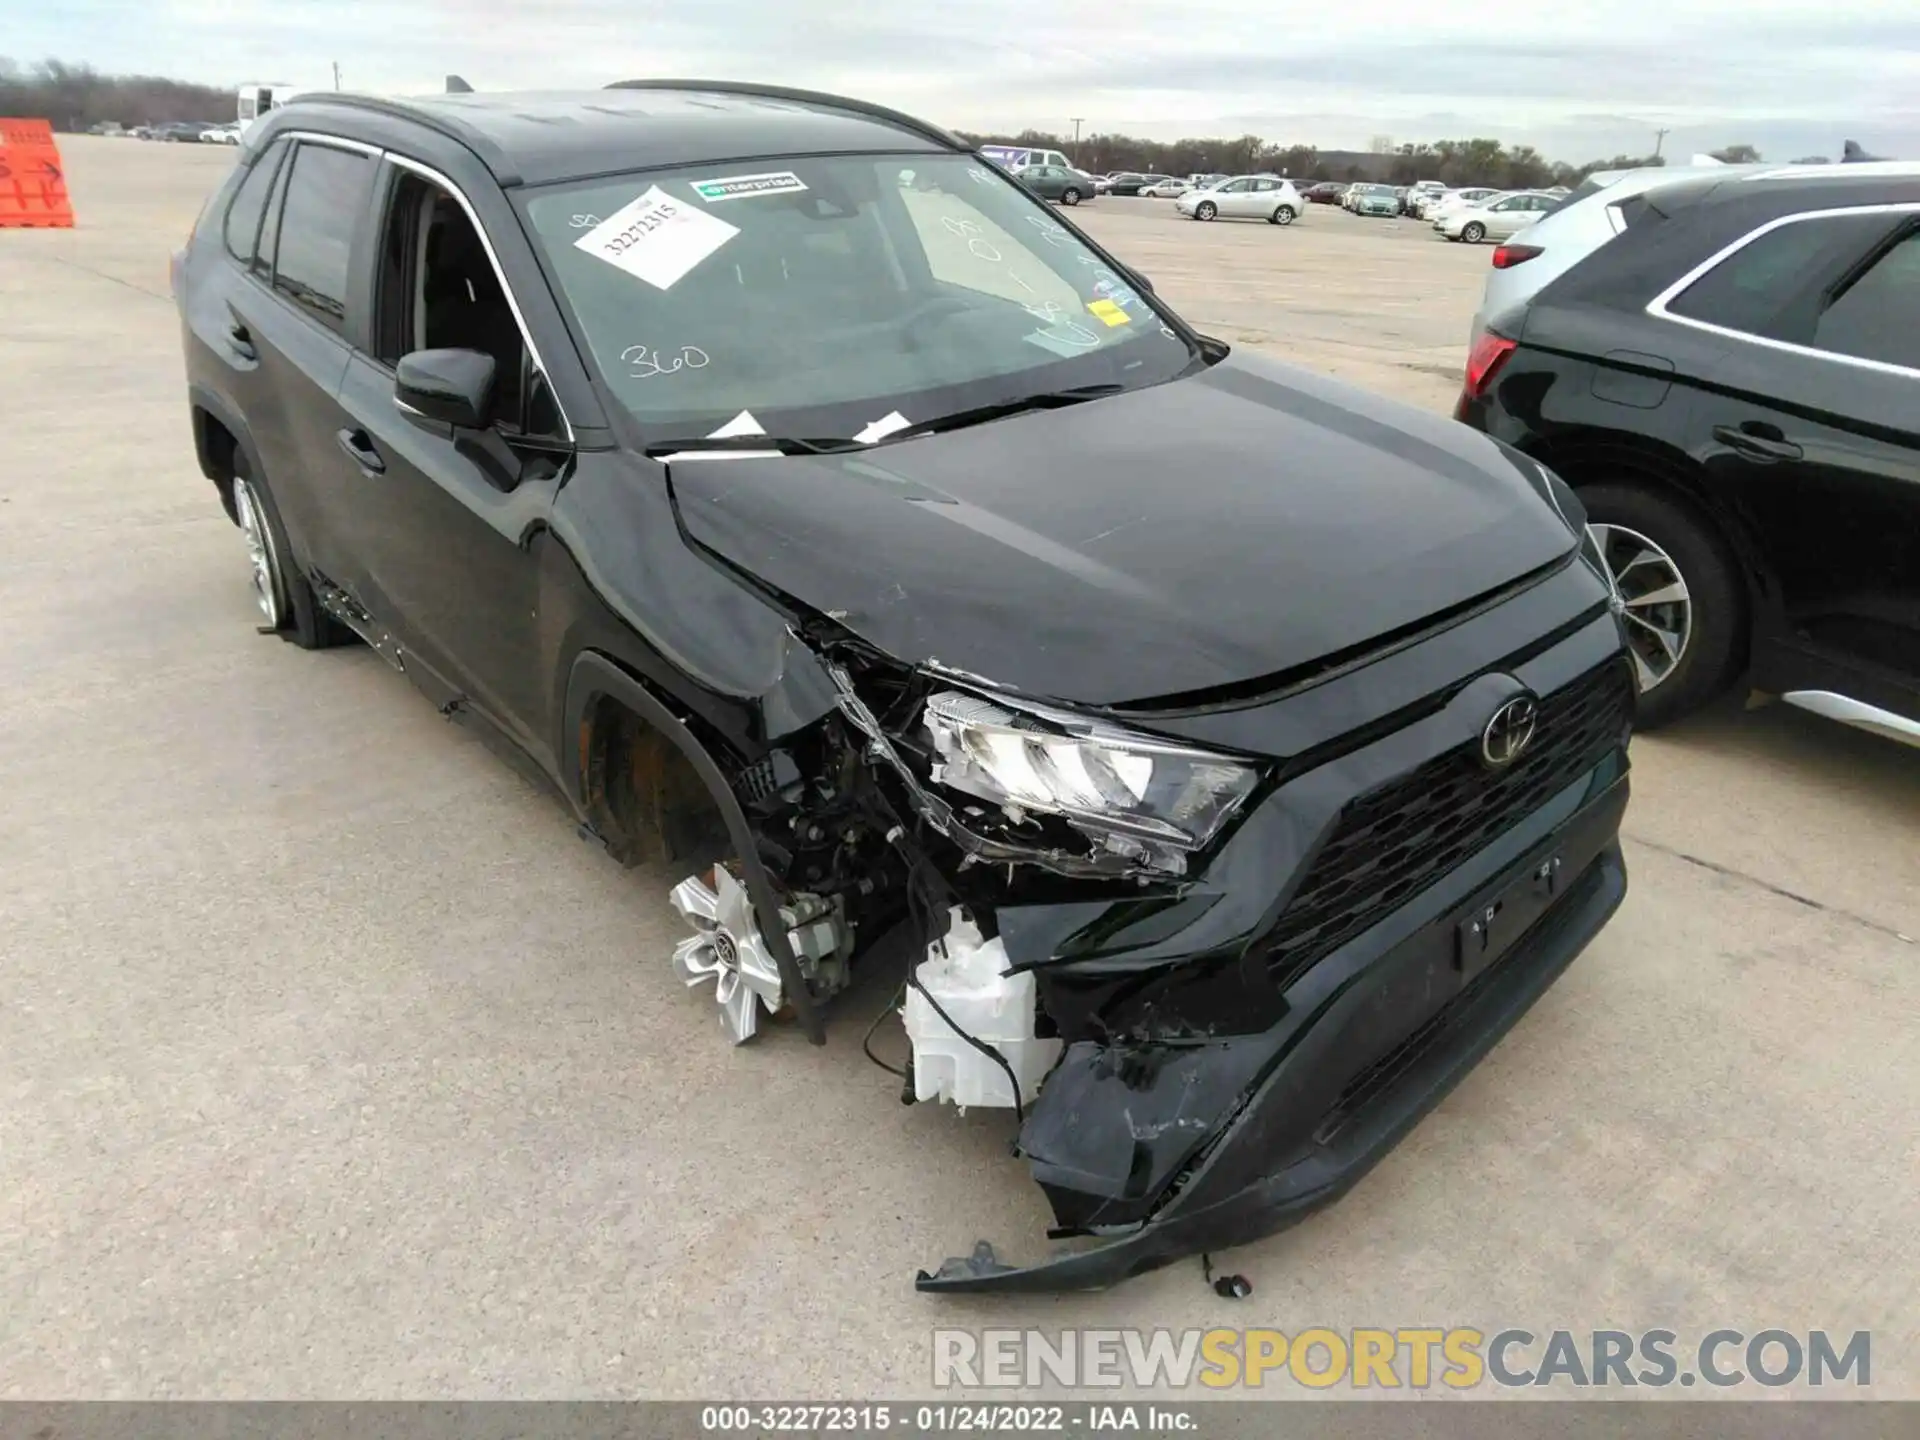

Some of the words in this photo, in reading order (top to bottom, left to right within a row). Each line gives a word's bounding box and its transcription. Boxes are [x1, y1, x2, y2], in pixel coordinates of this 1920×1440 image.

[703, 175, 801, 197] enterprise
[604, 203, 678, 256] 32272315
[620, 345, 710, 378] 360
